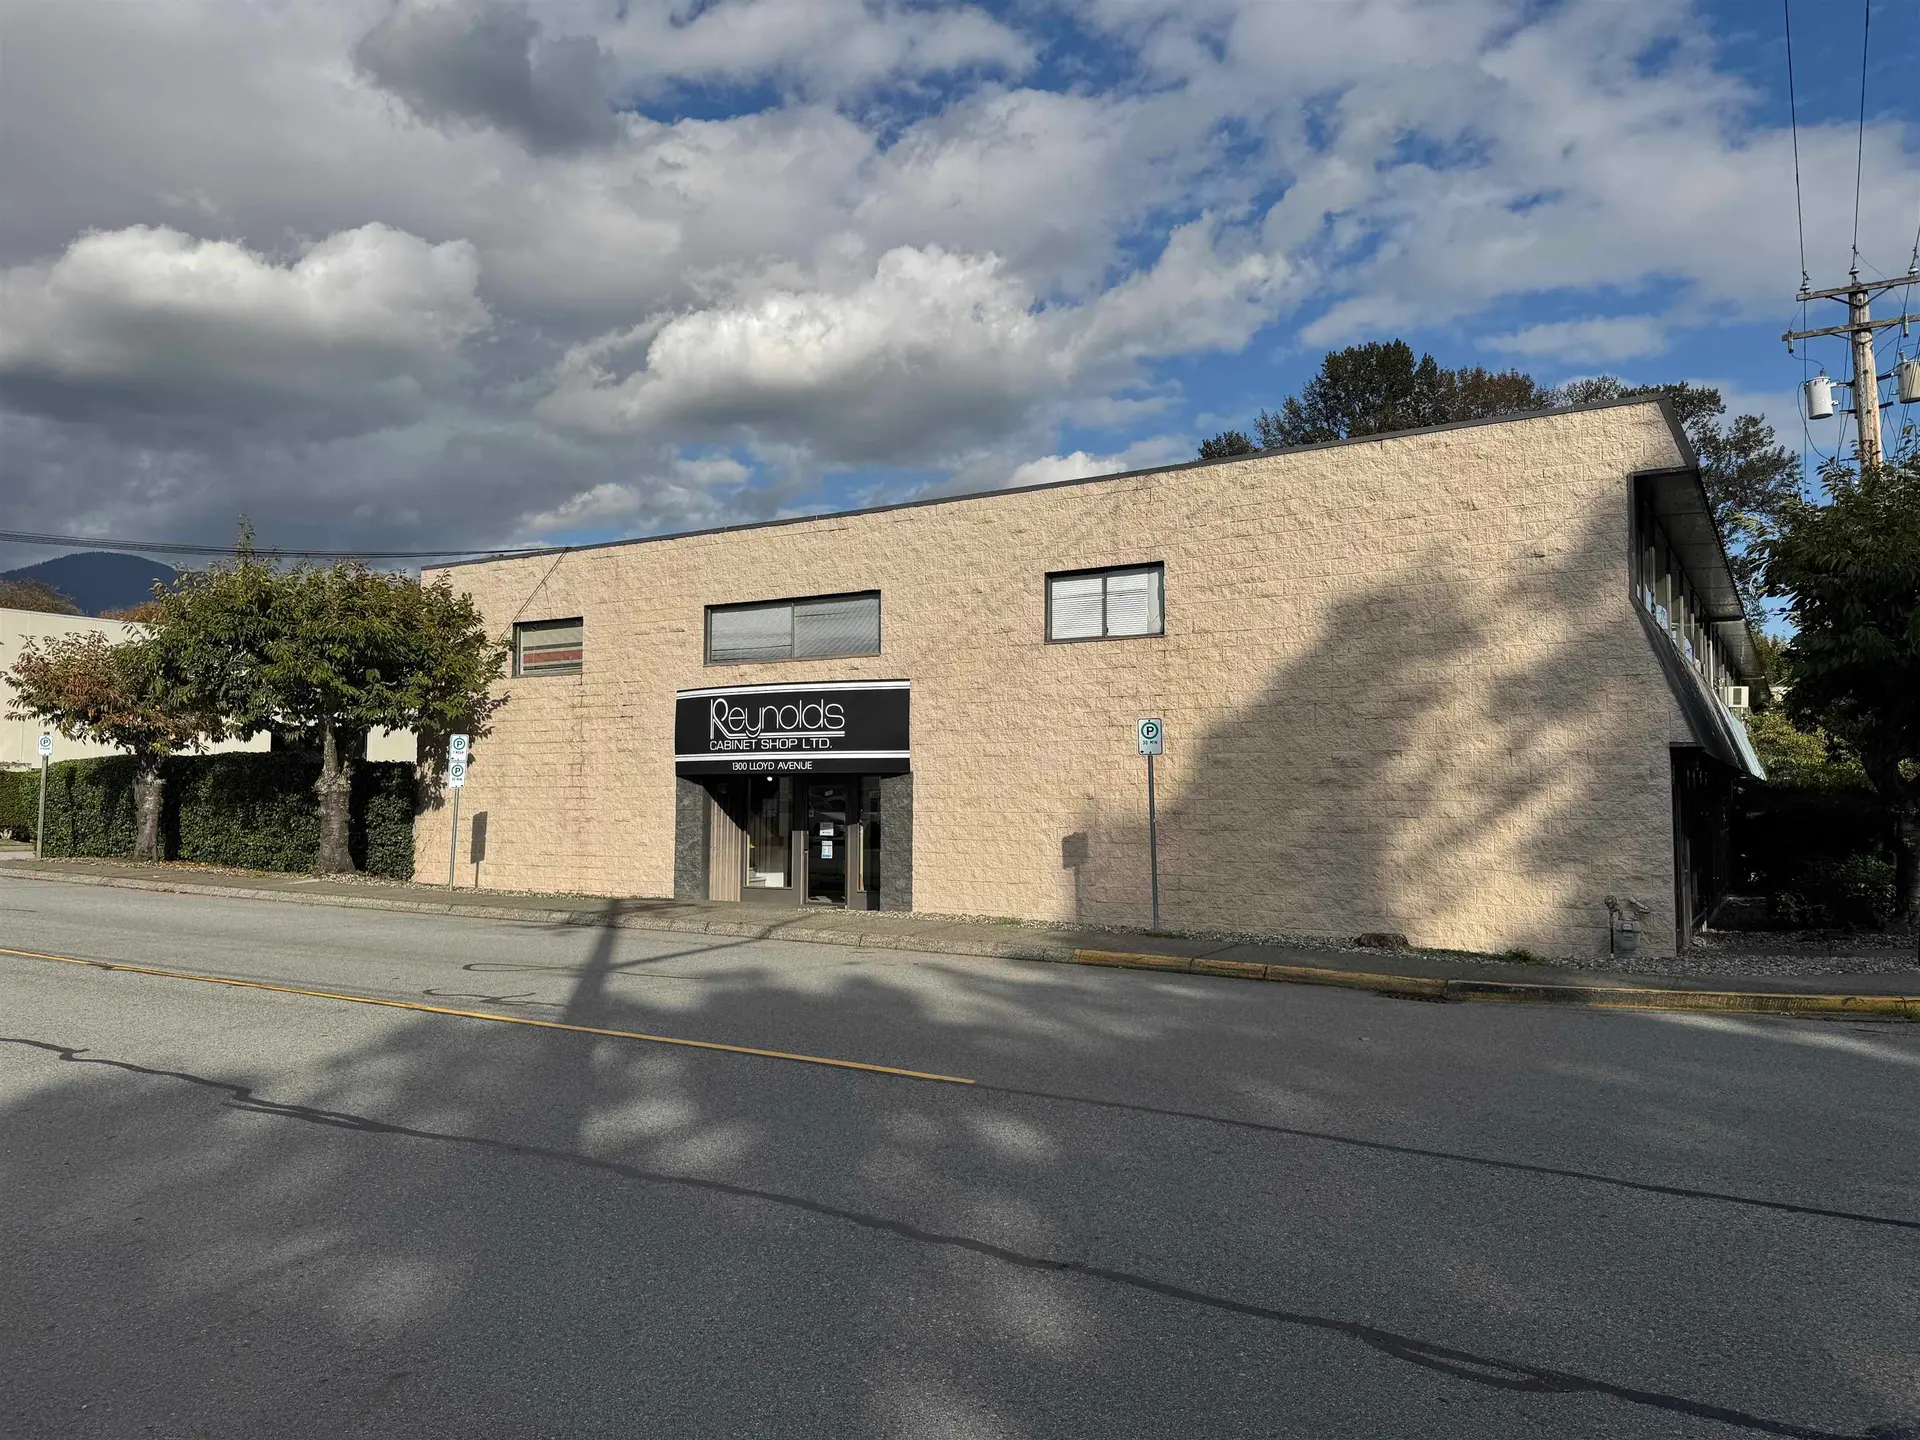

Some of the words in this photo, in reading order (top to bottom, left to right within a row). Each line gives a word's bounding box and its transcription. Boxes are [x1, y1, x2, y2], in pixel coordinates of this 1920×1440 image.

[710, 698, 845, 739] Reynolds
[1146, 726, 1155, 736] P
[709, 739, 757, 751] CABINET
[760, 738, 798, 750] SHOP
[802, 738, 833, 749] LTD.
[732, 762, 748, 771] 1300
[749, 761, 775, 771] LLOYD
[777, 761, 813, 770] AVENUE
